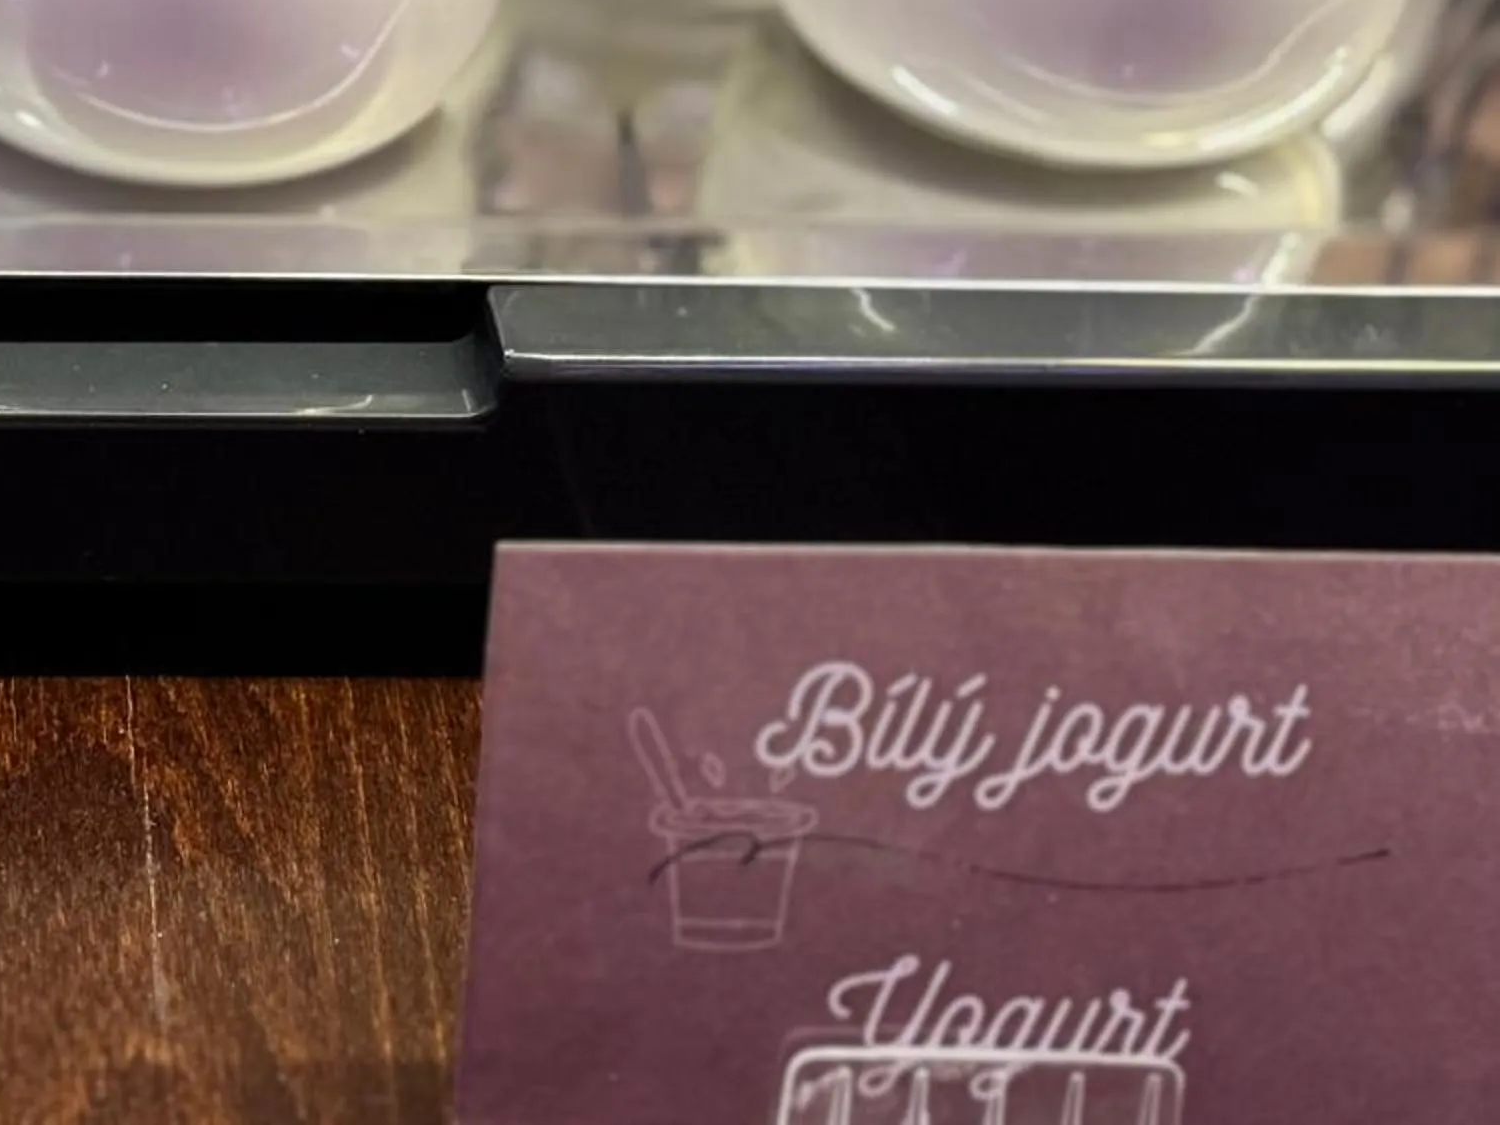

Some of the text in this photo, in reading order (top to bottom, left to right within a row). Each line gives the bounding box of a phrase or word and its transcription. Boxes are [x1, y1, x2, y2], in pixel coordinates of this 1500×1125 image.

[755, 661, 1312, 812] Bílý jogurt
[828, 954, 1192, 1101] Yogurt
